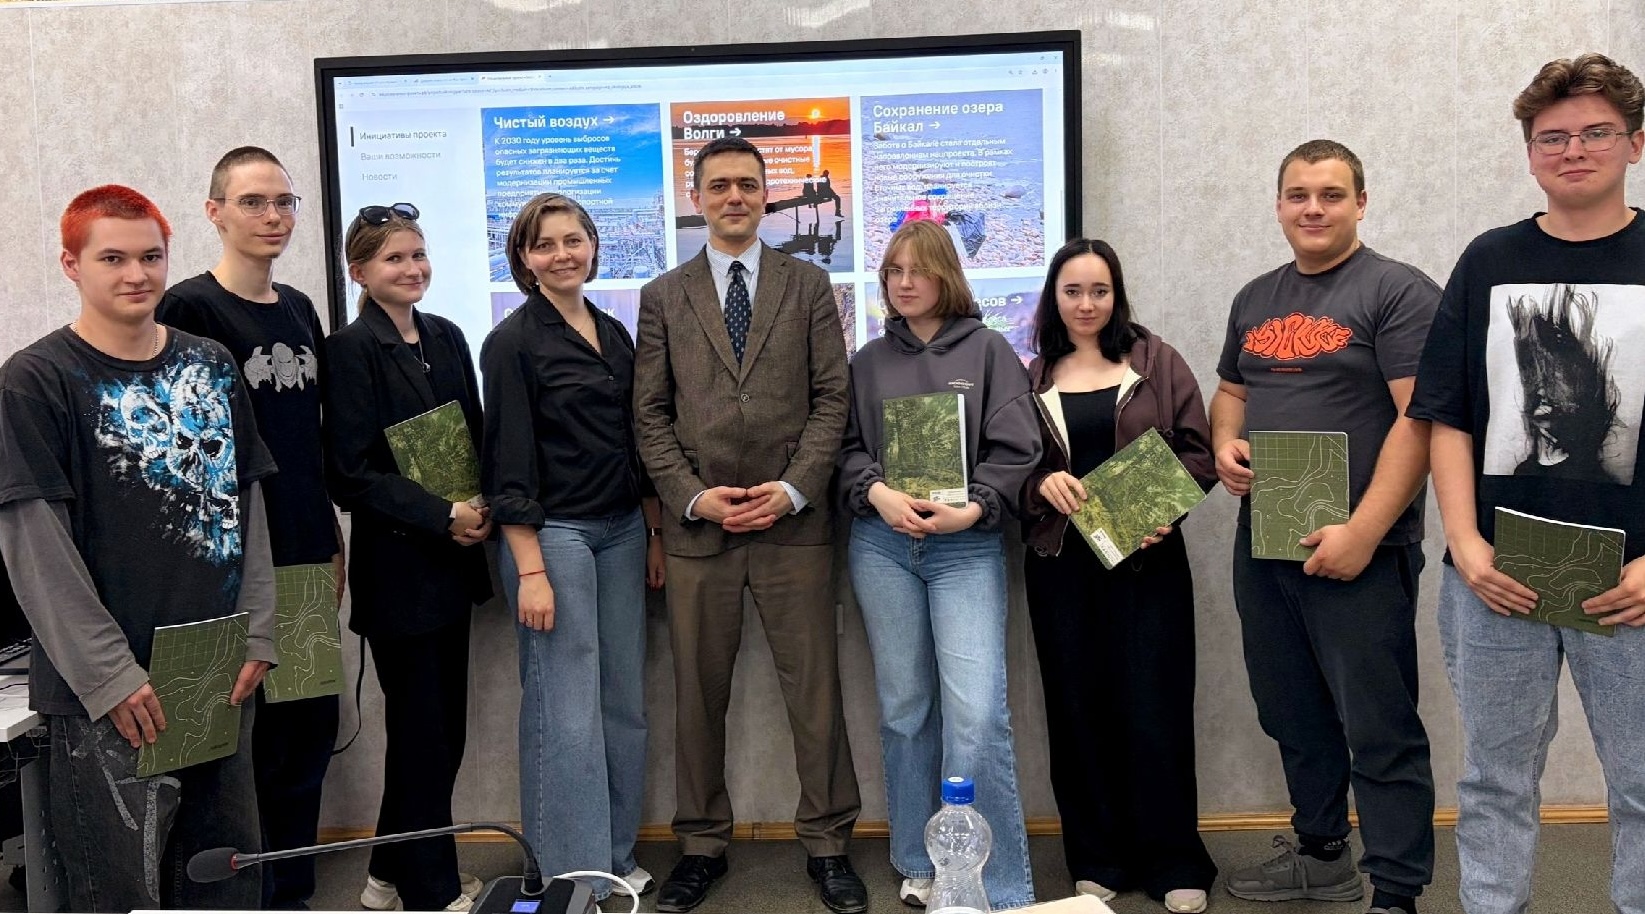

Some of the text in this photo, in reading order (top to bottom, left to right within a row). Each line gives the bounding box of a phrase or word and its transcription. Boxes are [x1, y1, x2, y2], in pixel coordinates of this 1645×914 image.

[873, 102, 1004, 118] Сохранение озера
[494, 115, 598, 130] Чистый воздух
[683, 110, 785, 126] Оздоровление
[873, 120, 924, 133] Байкал
[360, 131, 447, 140] Инициативы проекта
[683, 127, 725, 140] Волги
[501, 137, 522, 145] 2030
[541, 137, 572, 145] уровень
[573, 135, 610, 143] выбросов
[361, 152, 441, 160] Ваши возможности
[528, 147, 583, 155] загрязняющих
[583, 146, 616, 154] веществ
[495, 158, 517, 166] будет
[588, 155, 622, 164] Достичь
[362, 173, 398, 181] Новости
